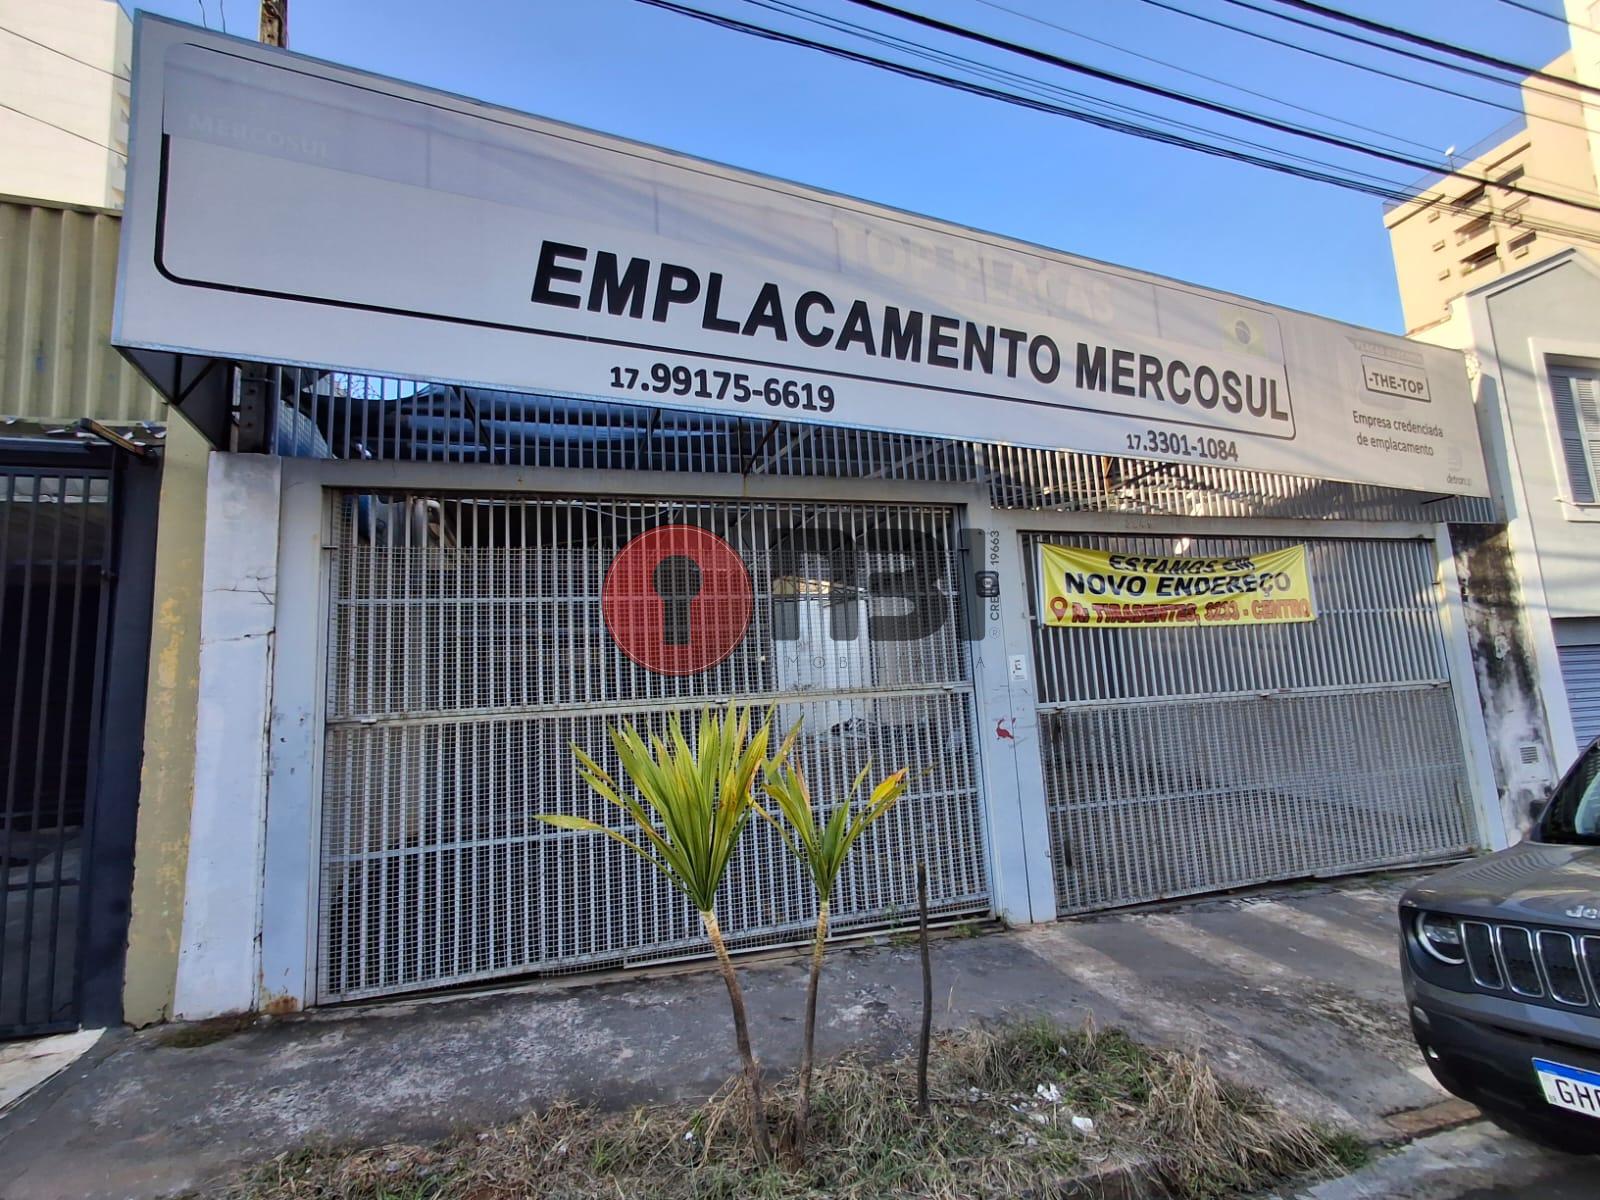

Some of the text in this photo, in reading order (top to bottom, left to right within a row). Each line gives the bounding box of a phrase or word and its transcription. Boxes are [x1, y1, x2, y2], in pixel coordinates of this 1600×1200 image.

[530, 240, 1290, 422] EMPLACAMENTO MERCOSUL
[610, 362, 835, 413] 17.99175-6619
[1353, 410, 1444, 438] Empresa credenciada
[1126, 429, 1239, 462] 17.3301-1084
[1356, 432, 1434, 457] de emplacamento
[1109, 555, 1256, 575] ESTAMOS EM
[1065, 571, 1292, 598] NOVO ENDEREÇO
[1251, 599, 1310, 620] CENTRO
[1565, 904, 1600, 919] Je
